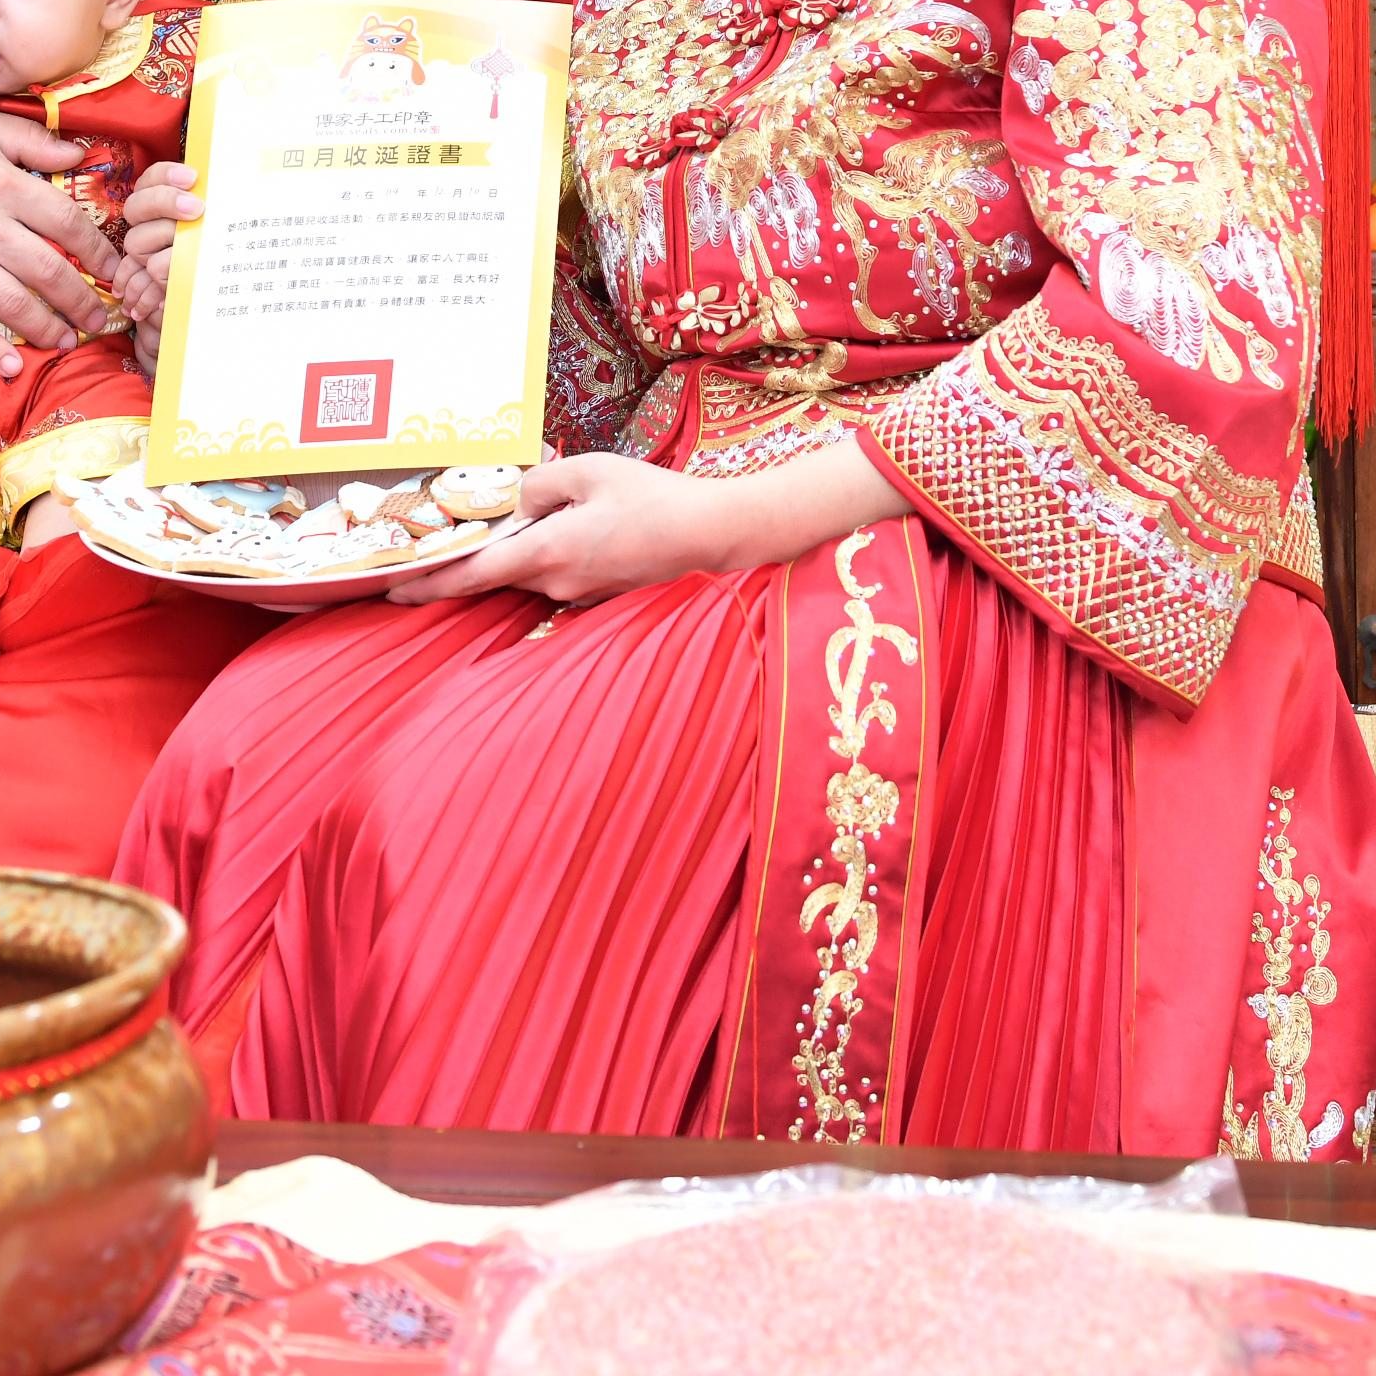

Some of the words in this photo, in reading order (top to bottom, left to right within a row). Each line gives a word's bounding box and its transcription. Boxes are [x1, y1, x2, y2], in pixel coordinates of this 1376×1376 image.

[315, 110, 433, 128] 傳家手工印章
[282, 143, 464, 168] 四月收涎證書
